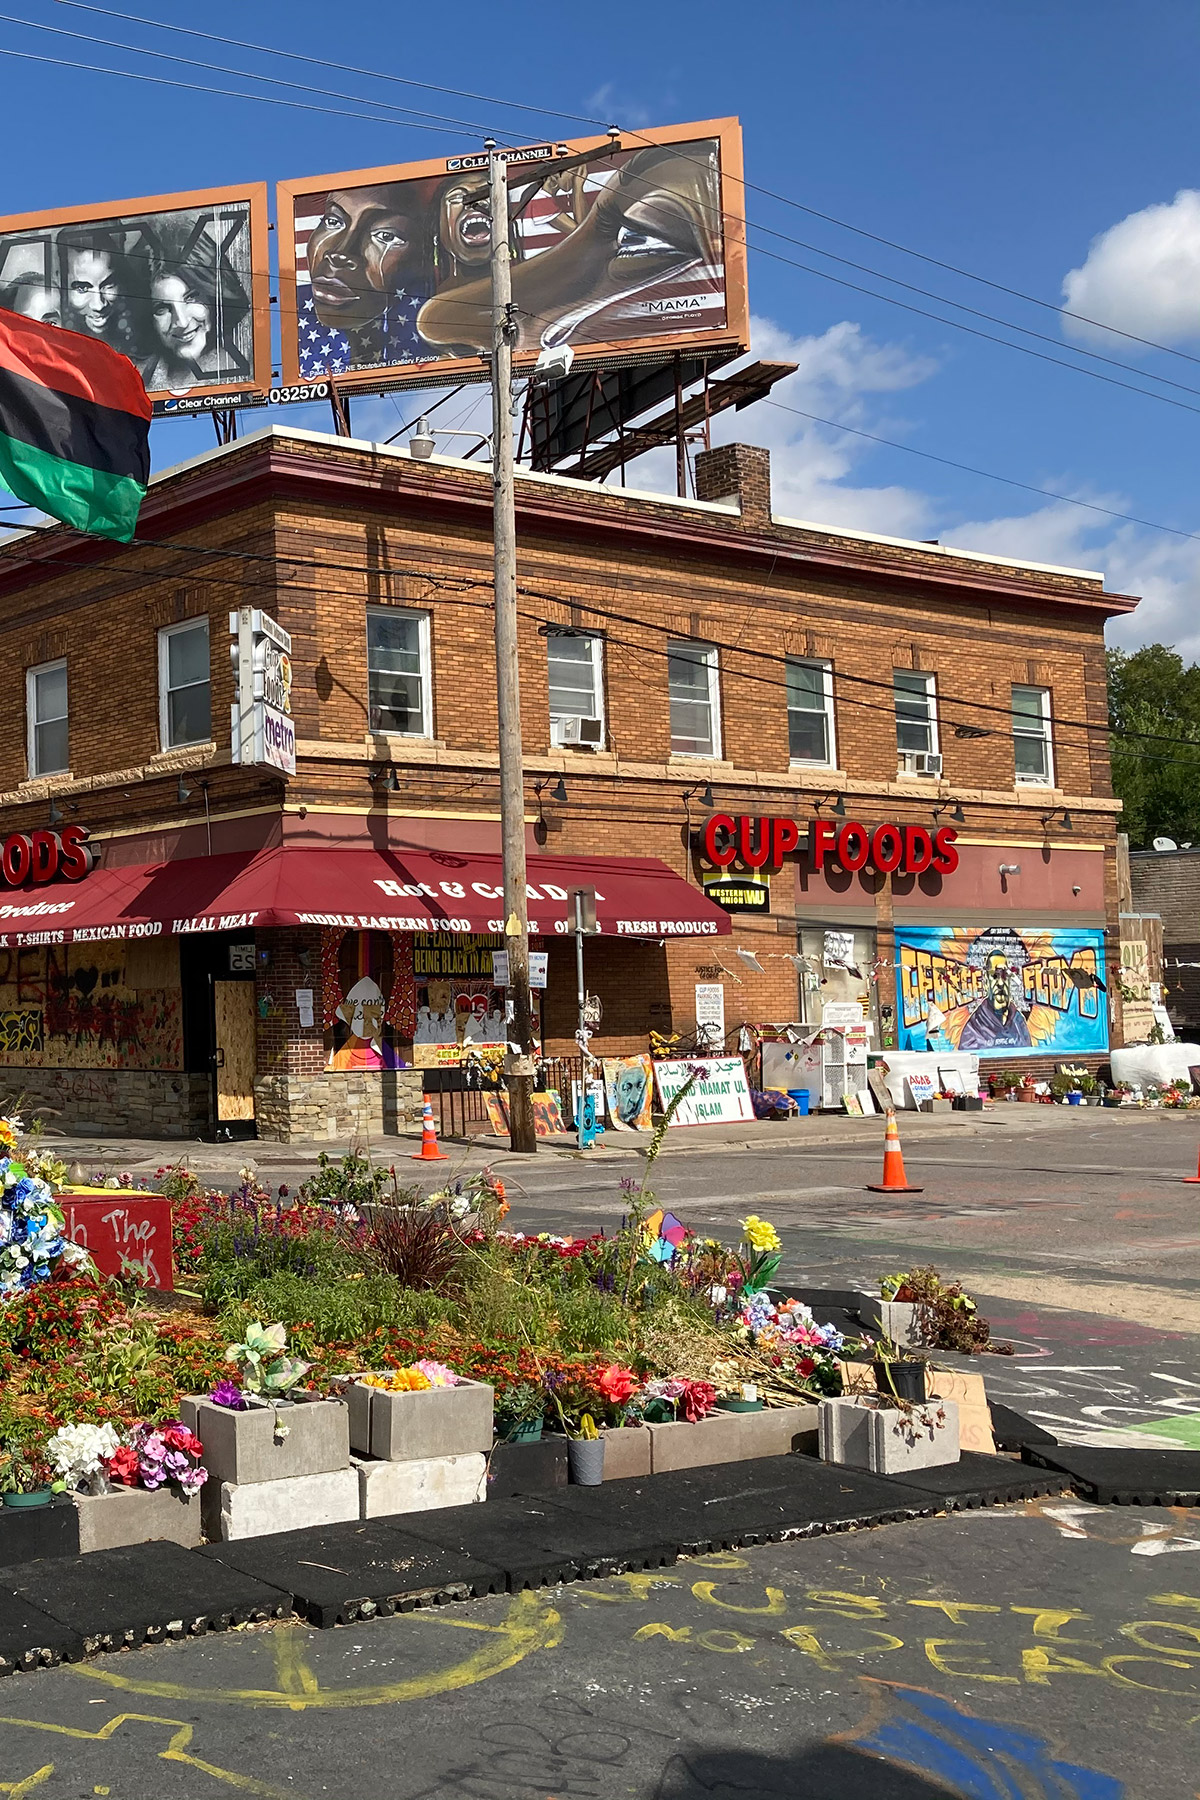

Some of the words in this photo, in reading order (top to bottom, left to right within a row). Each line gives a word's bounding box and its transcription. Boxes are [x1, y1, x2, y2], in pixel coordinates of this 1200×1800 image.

[498, 148, 551, 162] CHANNEL
[641, 296, 707, 313] "MAMA"
[357, 361, 387, 370] Sculpture
[391, 358, 415, 367] Gallery
[415, 354, 440, 364] Factory
[178, 396, 203, 410] Clear
[203, 393, 242, 408] Channel
[269, 383, 328, 404] 032570
[265, 713, 294, 756] metro
[705, 813, 799, 868] CUP
[814, 820, 960, 875] FOODS
[373, 879, 439, 898] Hot
[439, 881, 466, 899] &
[471, 882, 546, 900] Cod
[708, 888, 744, 897] WESTERN
[720, 896, 744, 905] UNION
[17, 930, 65, 945] T-SHIRTS
[73, 925, 126, 942] MEXICAN
[128, 921, 163, 938] FOOD
[172, 915, 216, 933] HALAL
[218, 911, 259, 930] MEAT
[294, 912, 358, 928] MIDDLE
[358, 915, 429, 931] EASTERN
[432, 917, 472, 933] FOOD
[616, 920, 657, 934] FRESH
[660, 920, 718, 934] PRODUCE
[414, 949, 440, 973] BEING
[441, 949, 469, 973] BLACK
[699, 1081, 731, 1096] NIAMAT
[734, 1080, 747, 1094] UL
[909, 1074, 931, 1086] ACAB
[695, 1102, 723, 1117] ISLAM
[101, 1208, 157, 1244] The
